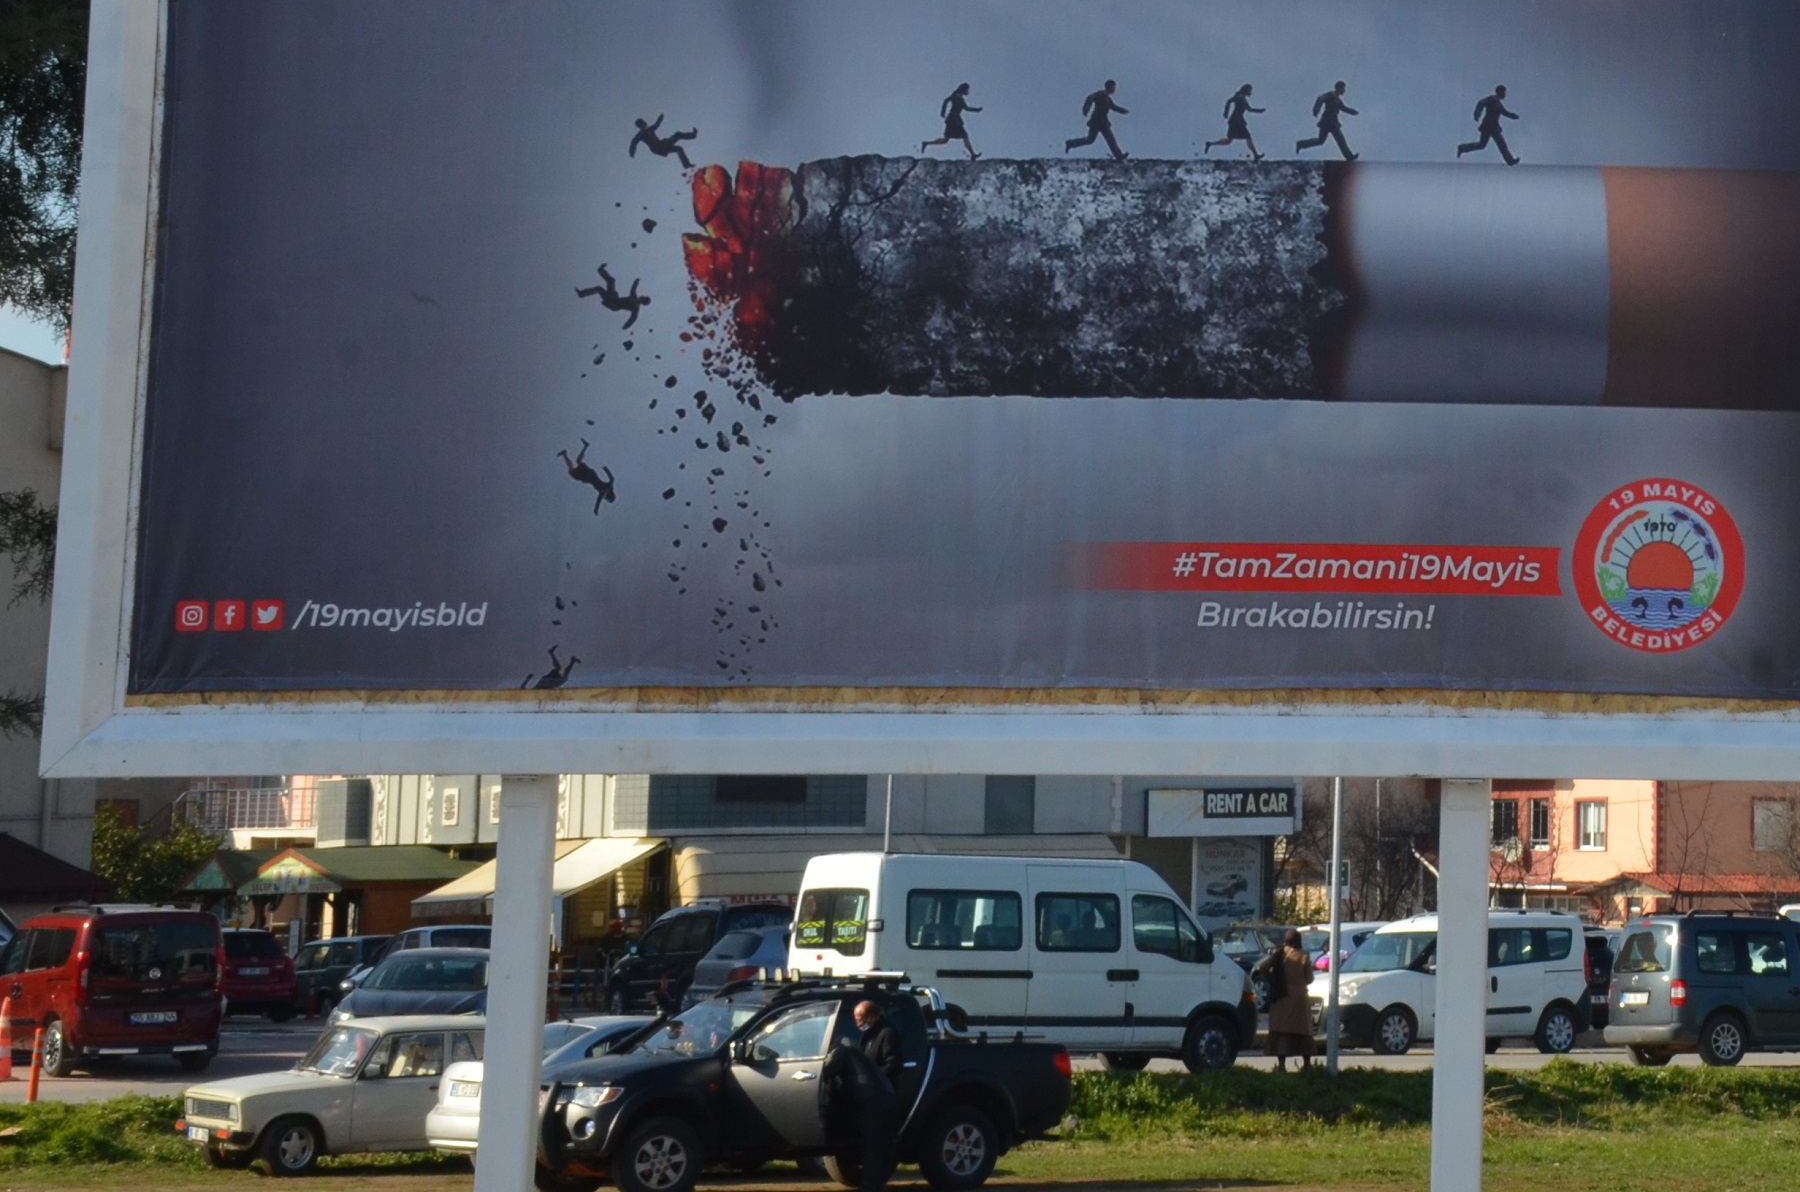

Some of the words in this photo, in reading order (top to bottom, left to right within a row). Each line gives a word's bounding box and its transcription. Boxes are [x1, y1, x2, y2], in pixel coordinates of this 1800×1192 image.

[1609, 489, 1635, 510] 19
[1643, 483, 1716, 516] MAYIS
[1643, 521, 1677, 533] 1970
[1172, 551, 1542, 589] #TamZamani19Mayis
[291, 599, 488, 632] /19mayisbld
[1196, 601, 1436, 630] Bırakabilirsin!
[1591, 605, 1724, 649] BELEDİYESİ
[1206, 793, 1244, 814] RENT
[1245, 793, 1256, 813] A
[1259, 792, 1288, 813] CAR
